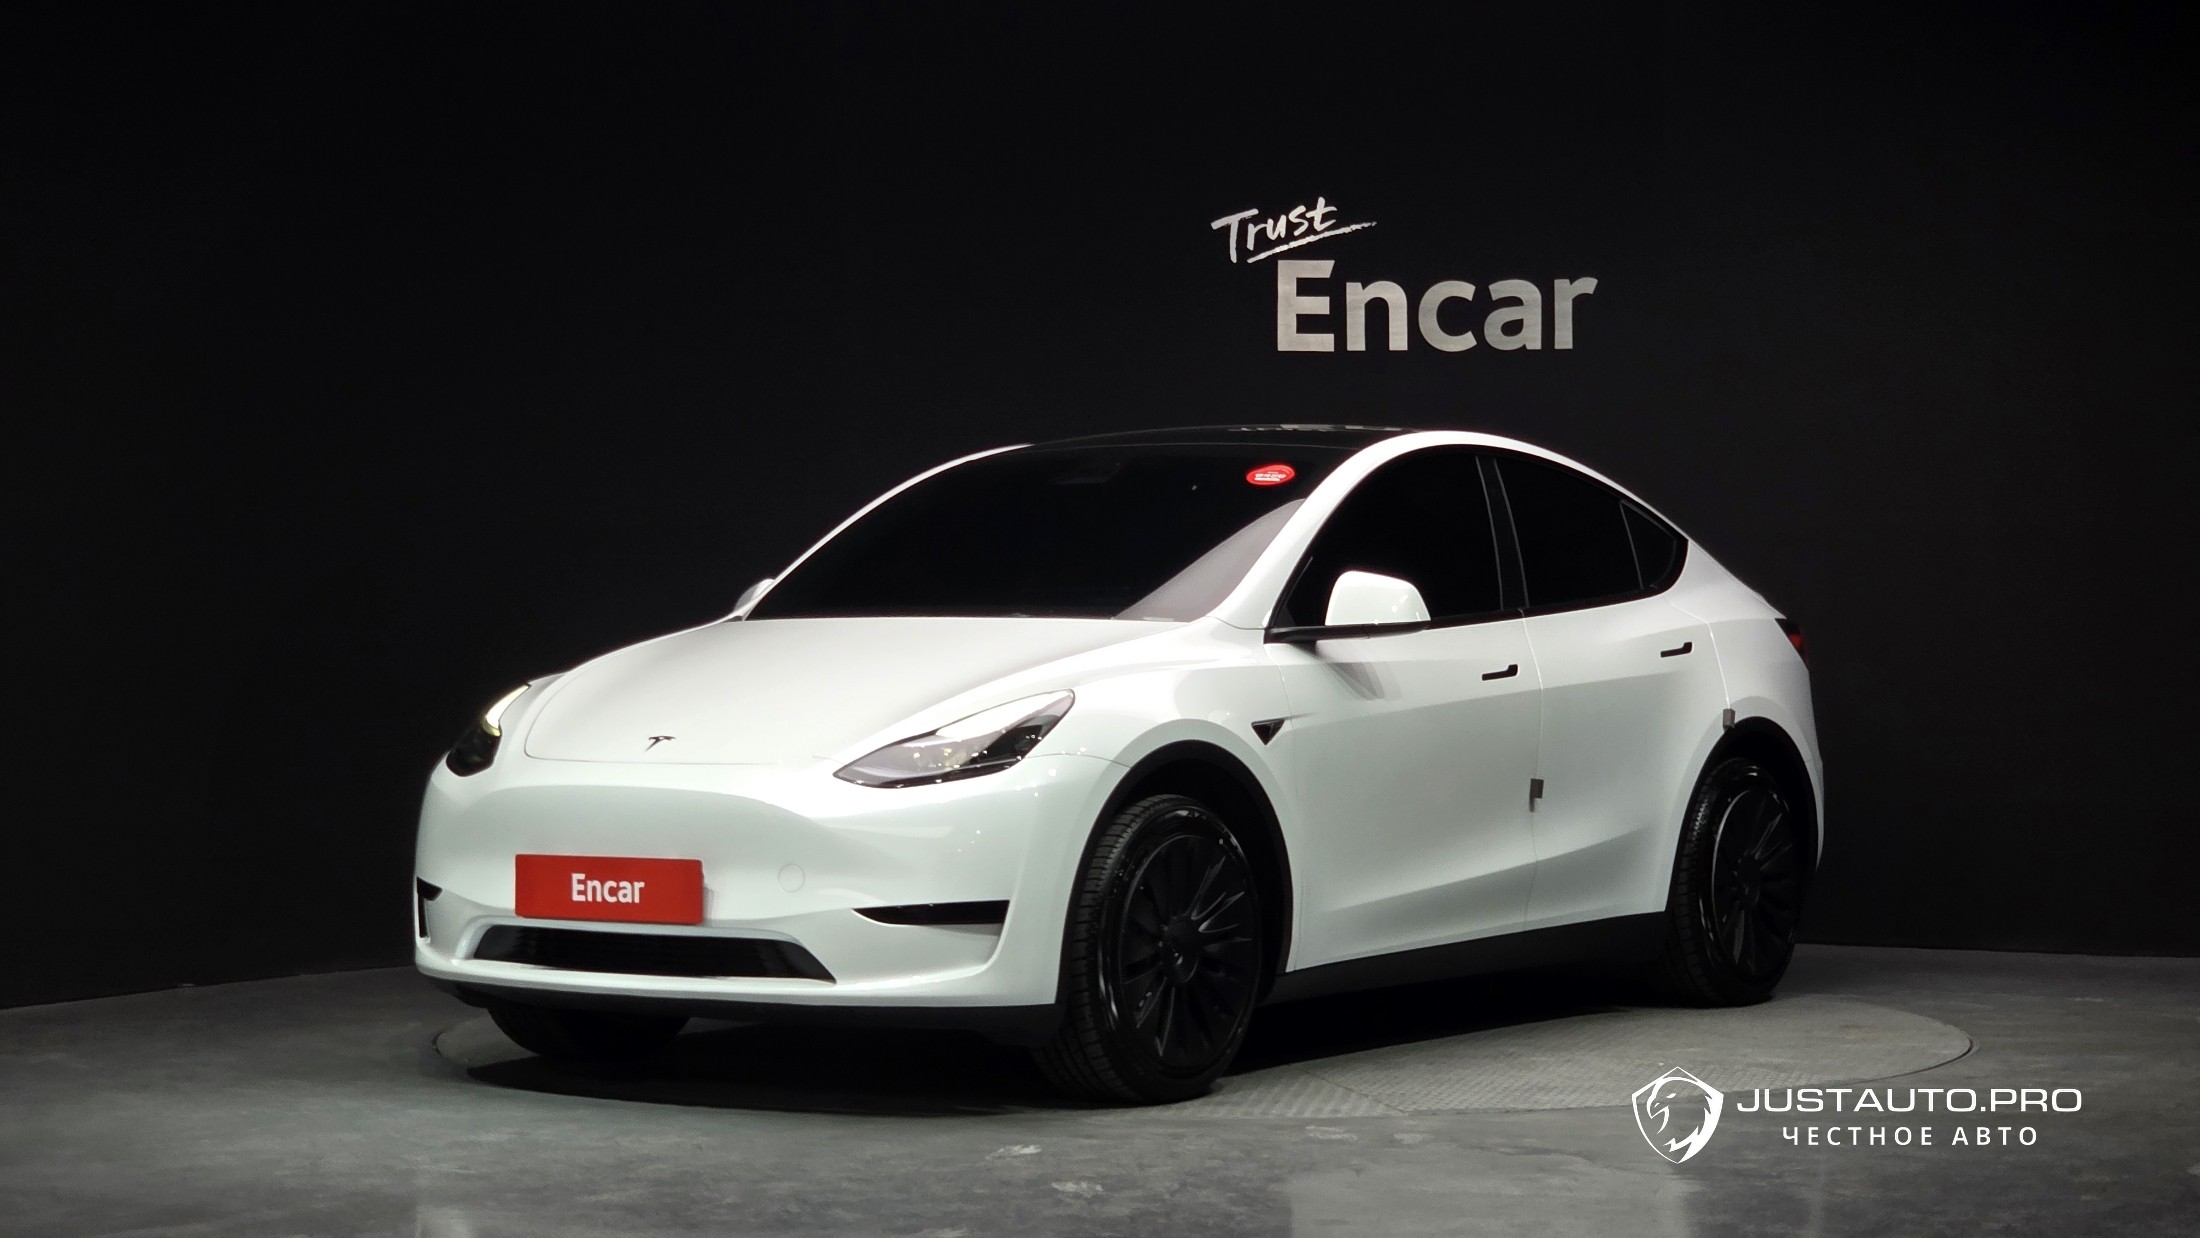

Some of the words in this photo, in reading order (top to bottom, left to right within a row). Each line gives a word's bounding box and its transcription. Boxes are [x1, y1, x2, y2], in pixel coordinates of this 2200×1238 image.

[1211, 197, 1339, 263] Trust
[1277, 259, 1599, 352] Encar
[571, 873, 645, 904] Encar
